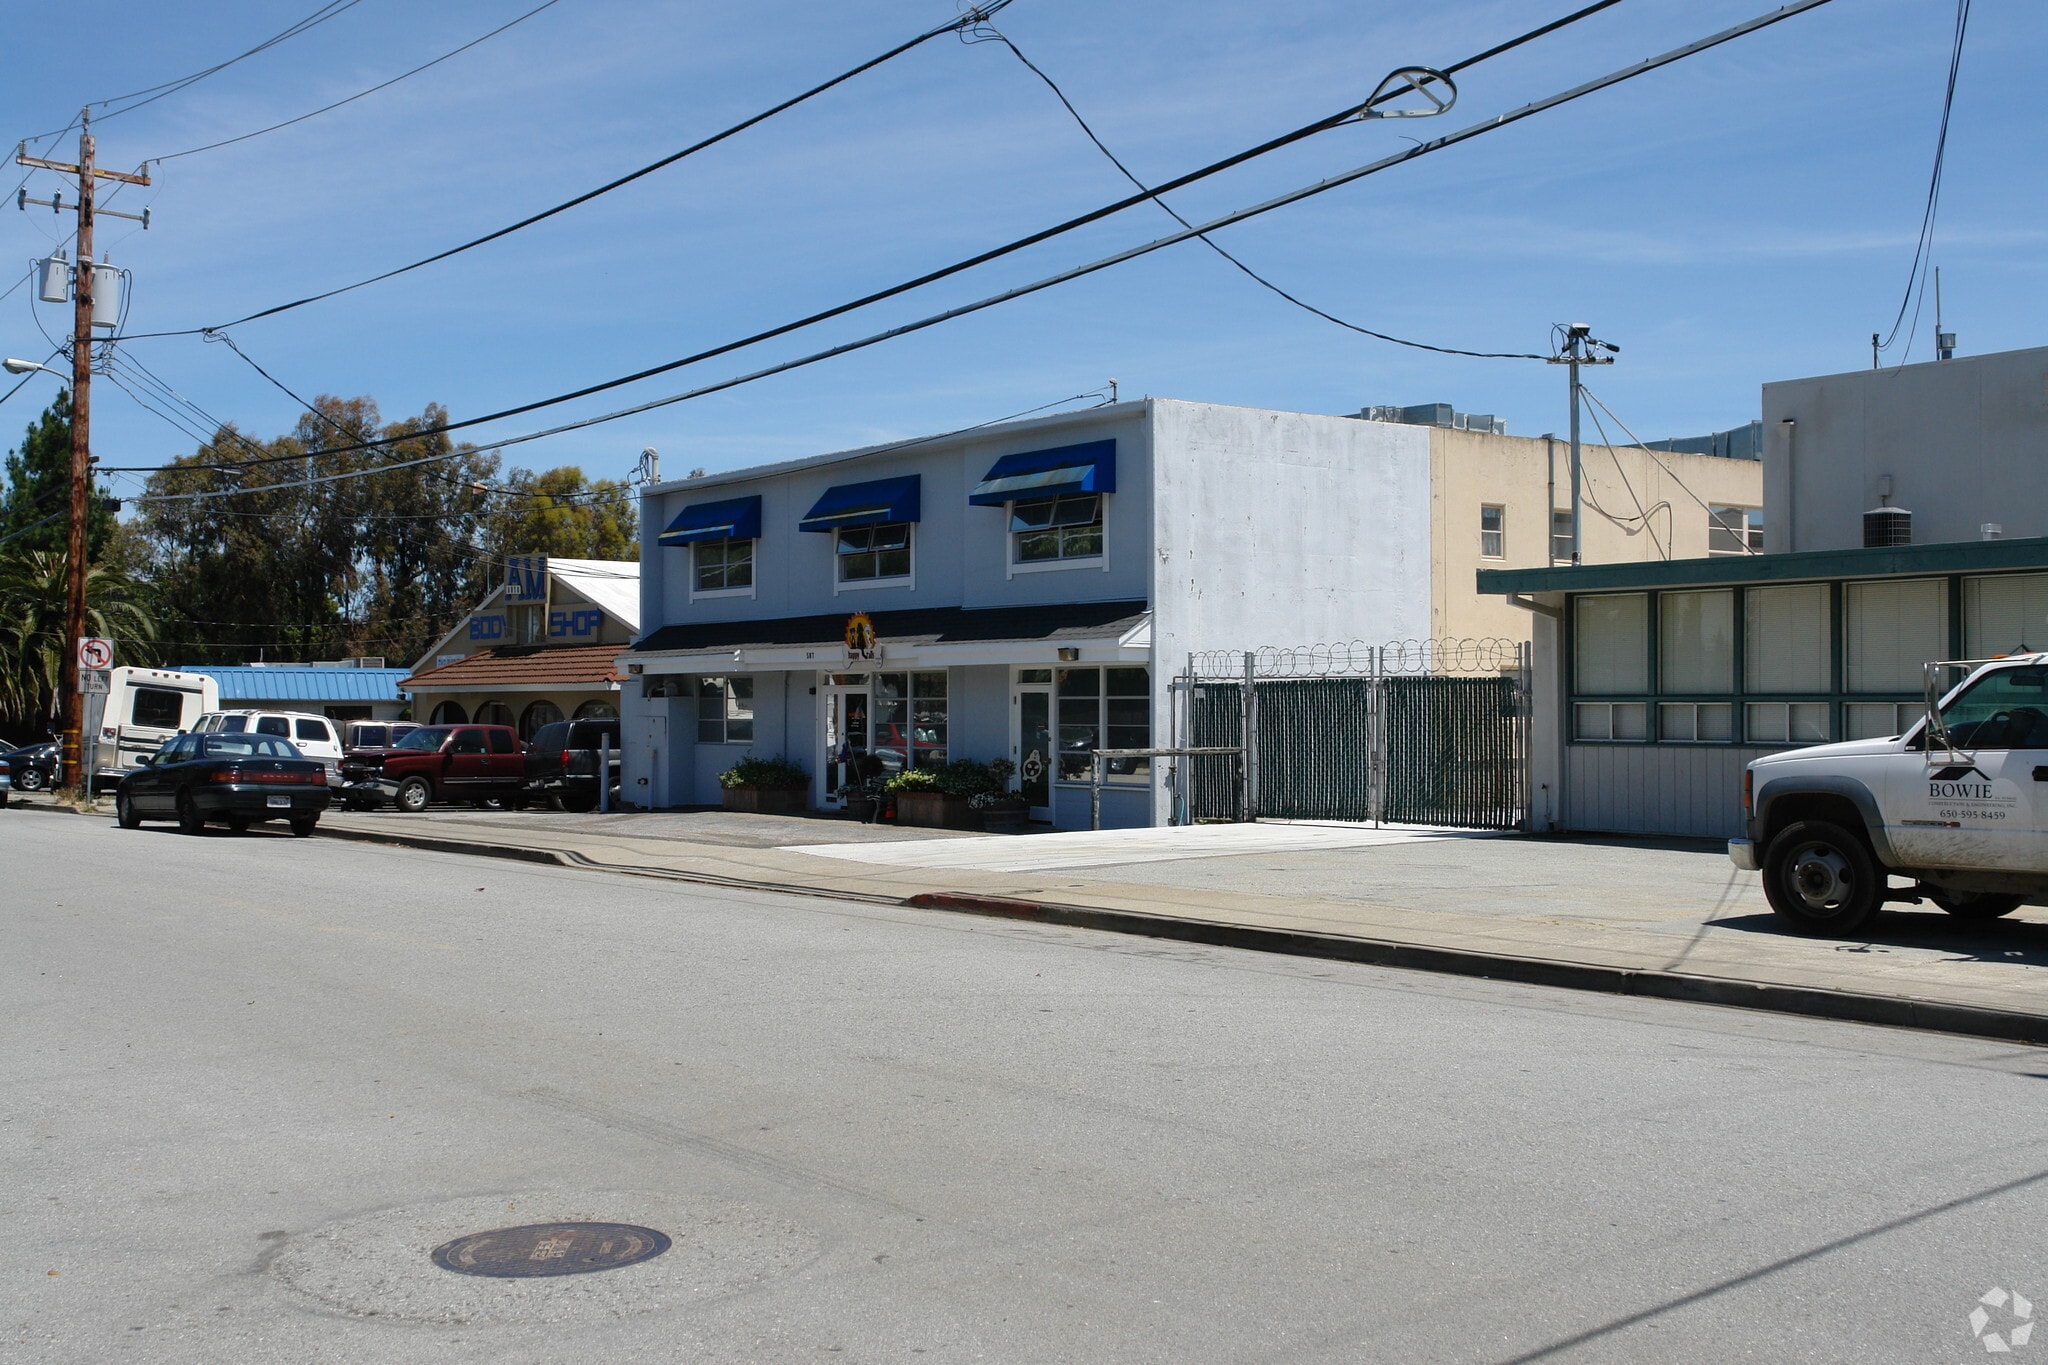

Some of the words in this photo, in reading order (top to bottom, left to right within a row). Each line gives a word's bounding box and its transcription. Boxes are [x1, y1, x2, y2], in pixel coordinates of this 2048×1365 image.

[504, 557, 545, 601] AM
[551, 610, 601, 637] SHOP
[1929, 783, 1992, 798] BOWIE
